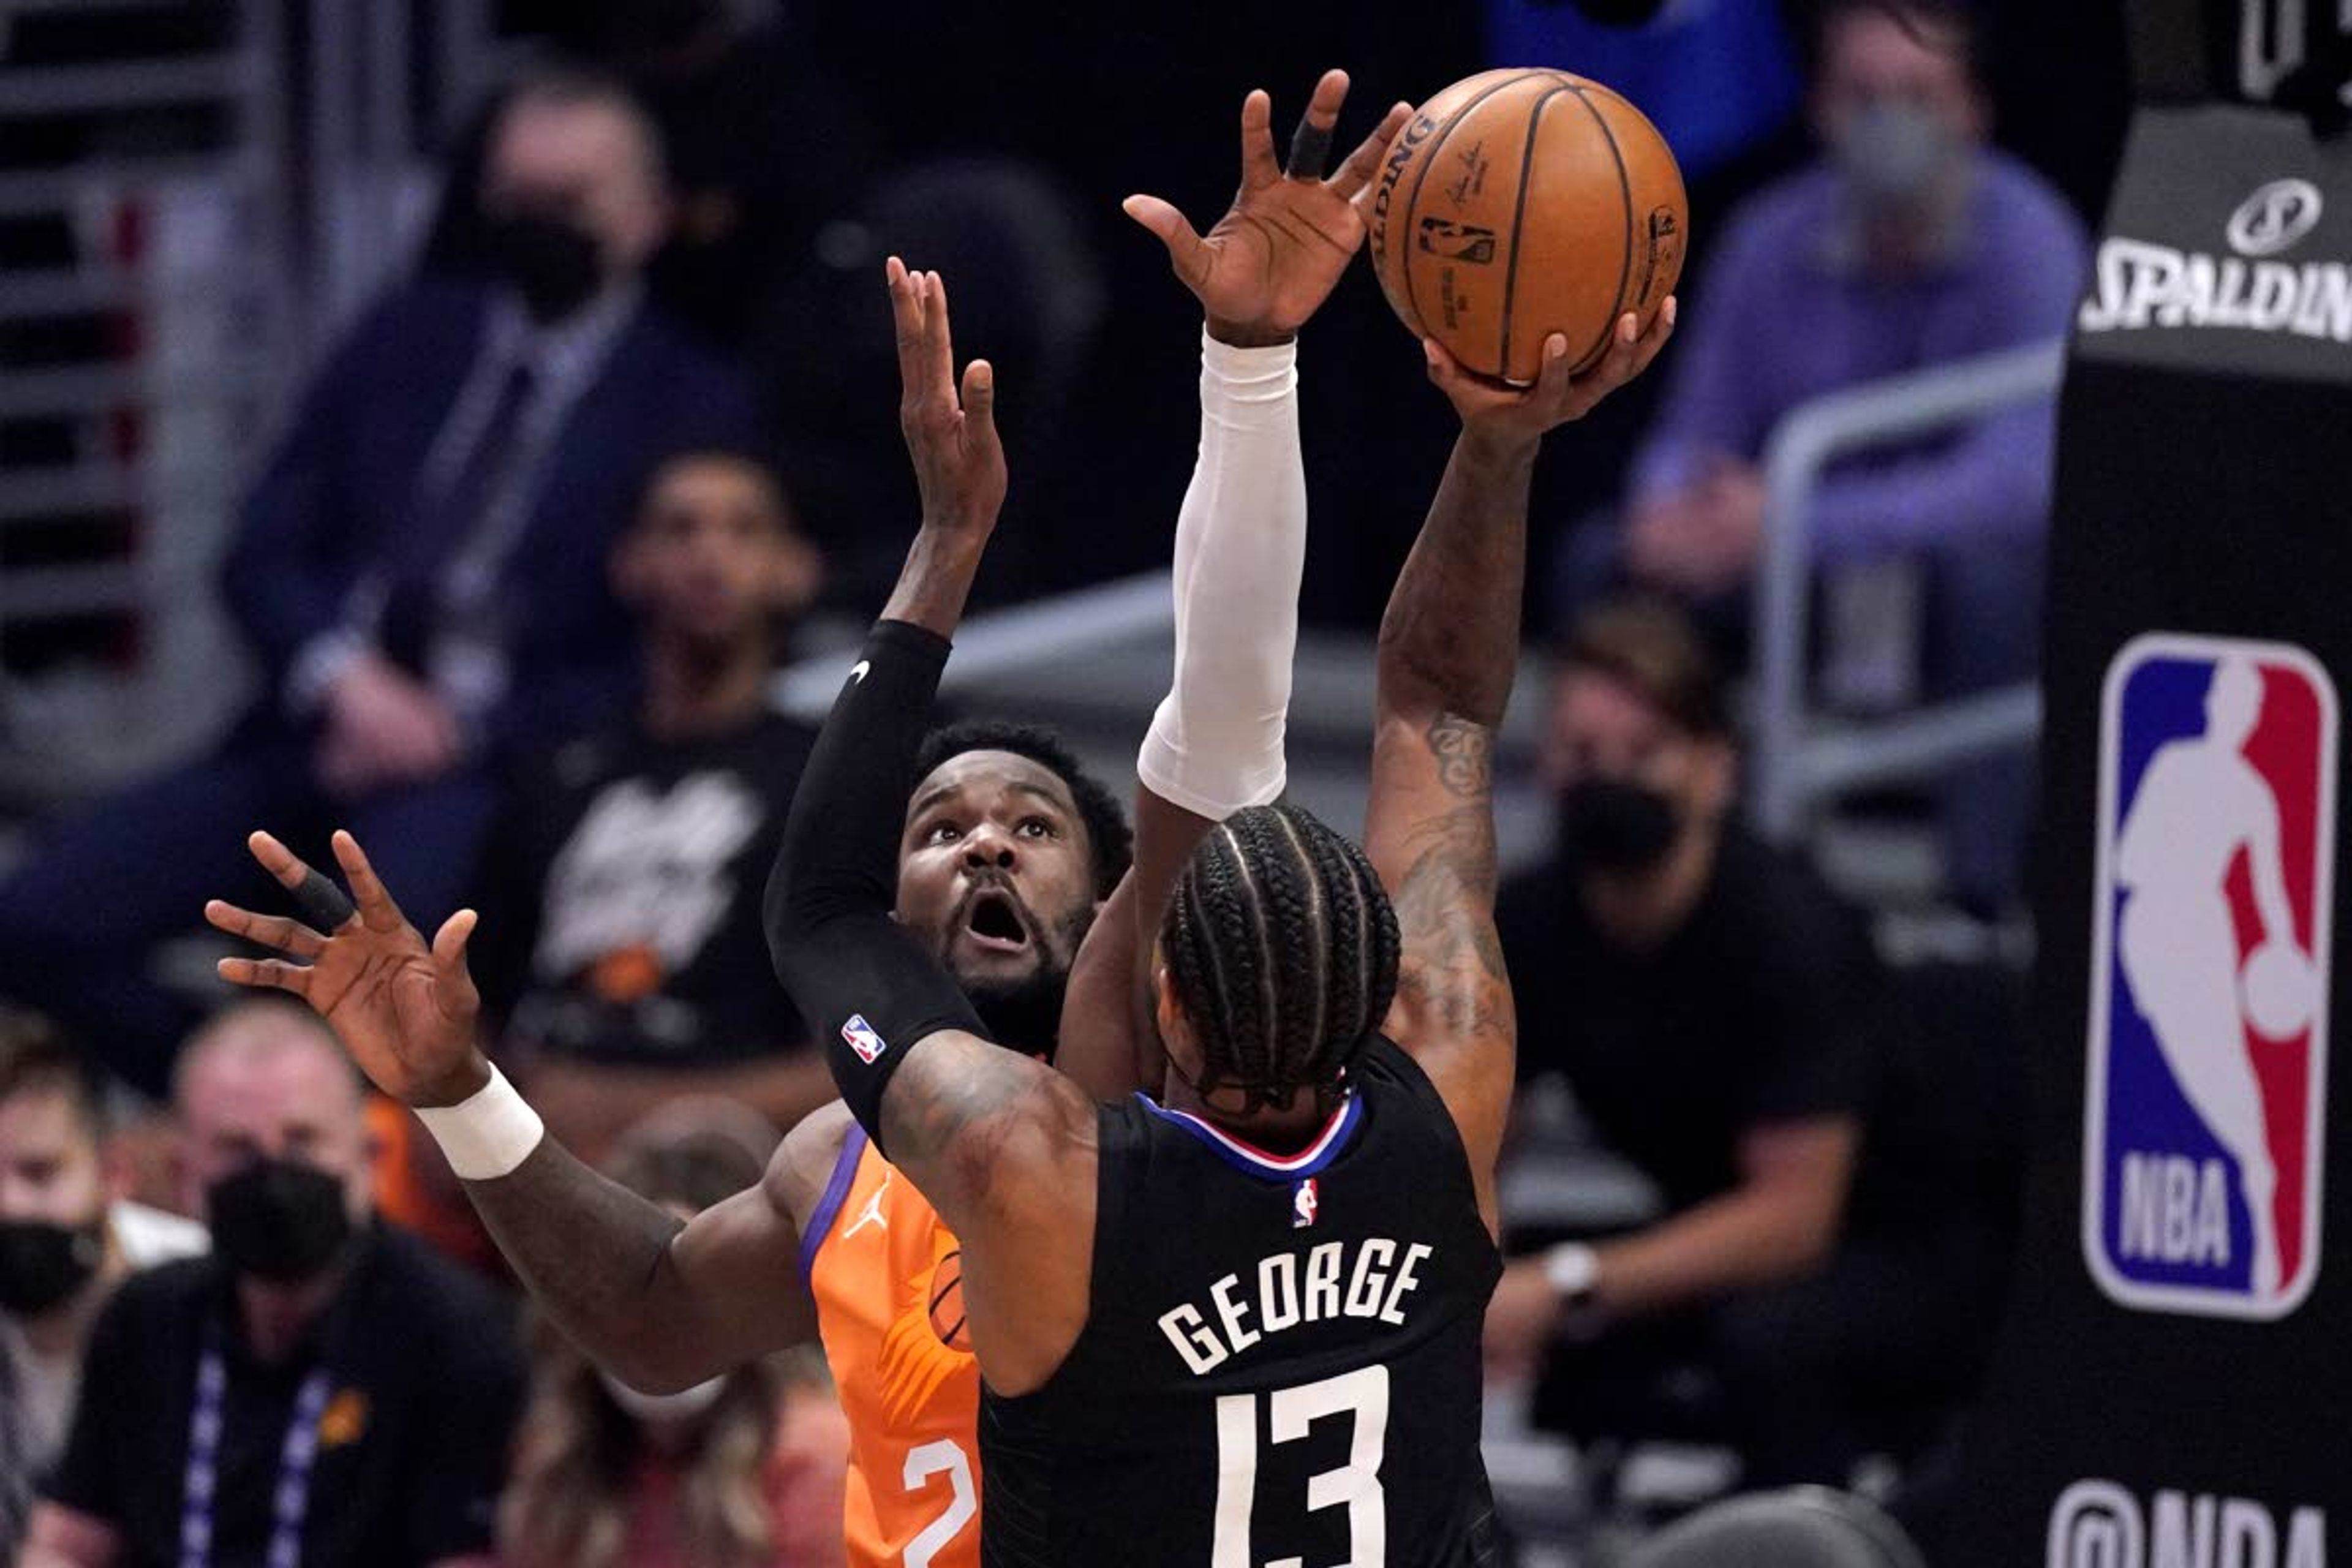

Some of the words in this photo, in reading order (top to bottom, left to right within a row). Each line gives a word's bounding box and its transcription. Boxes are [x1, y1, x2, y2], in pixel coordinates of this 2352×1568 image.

[2119, 1151, 2231, 1267] NBA
[1158, 1238, 1433, 1375] GEORGE
[1212, 1364, 1390, 1568] 13
